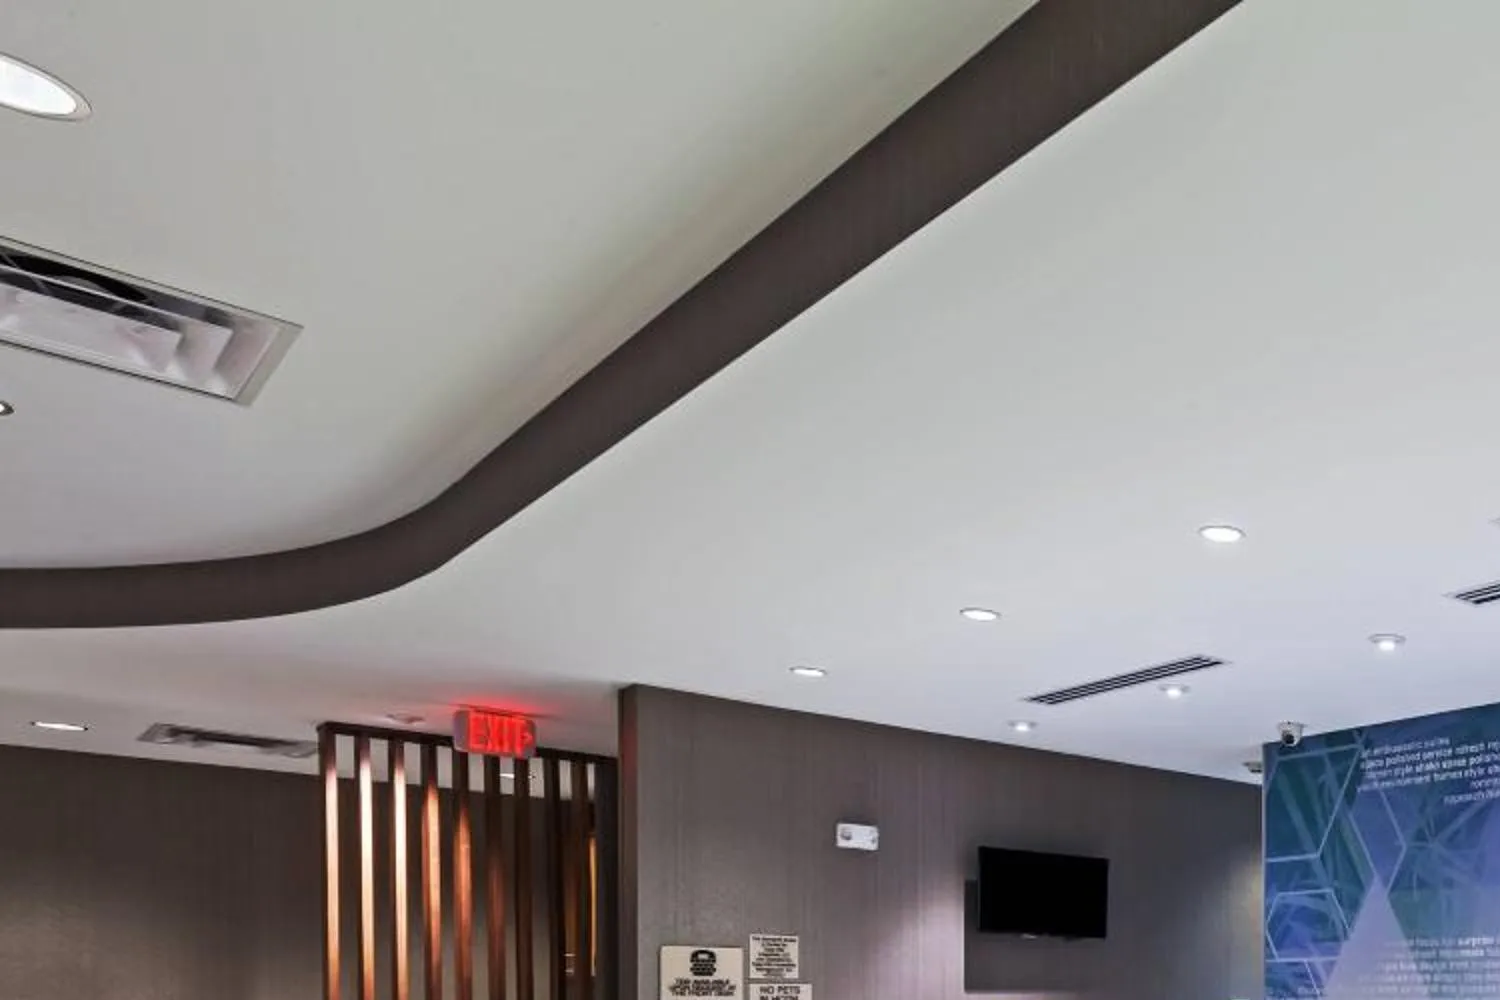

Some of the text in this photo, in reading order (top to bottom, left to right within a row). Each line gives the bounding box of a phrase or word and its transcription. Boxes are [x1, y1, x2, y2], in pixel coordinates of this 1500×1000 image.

[469, 711, 522, 758] EXIT
[760, 986, 800, 994] NO PETS
